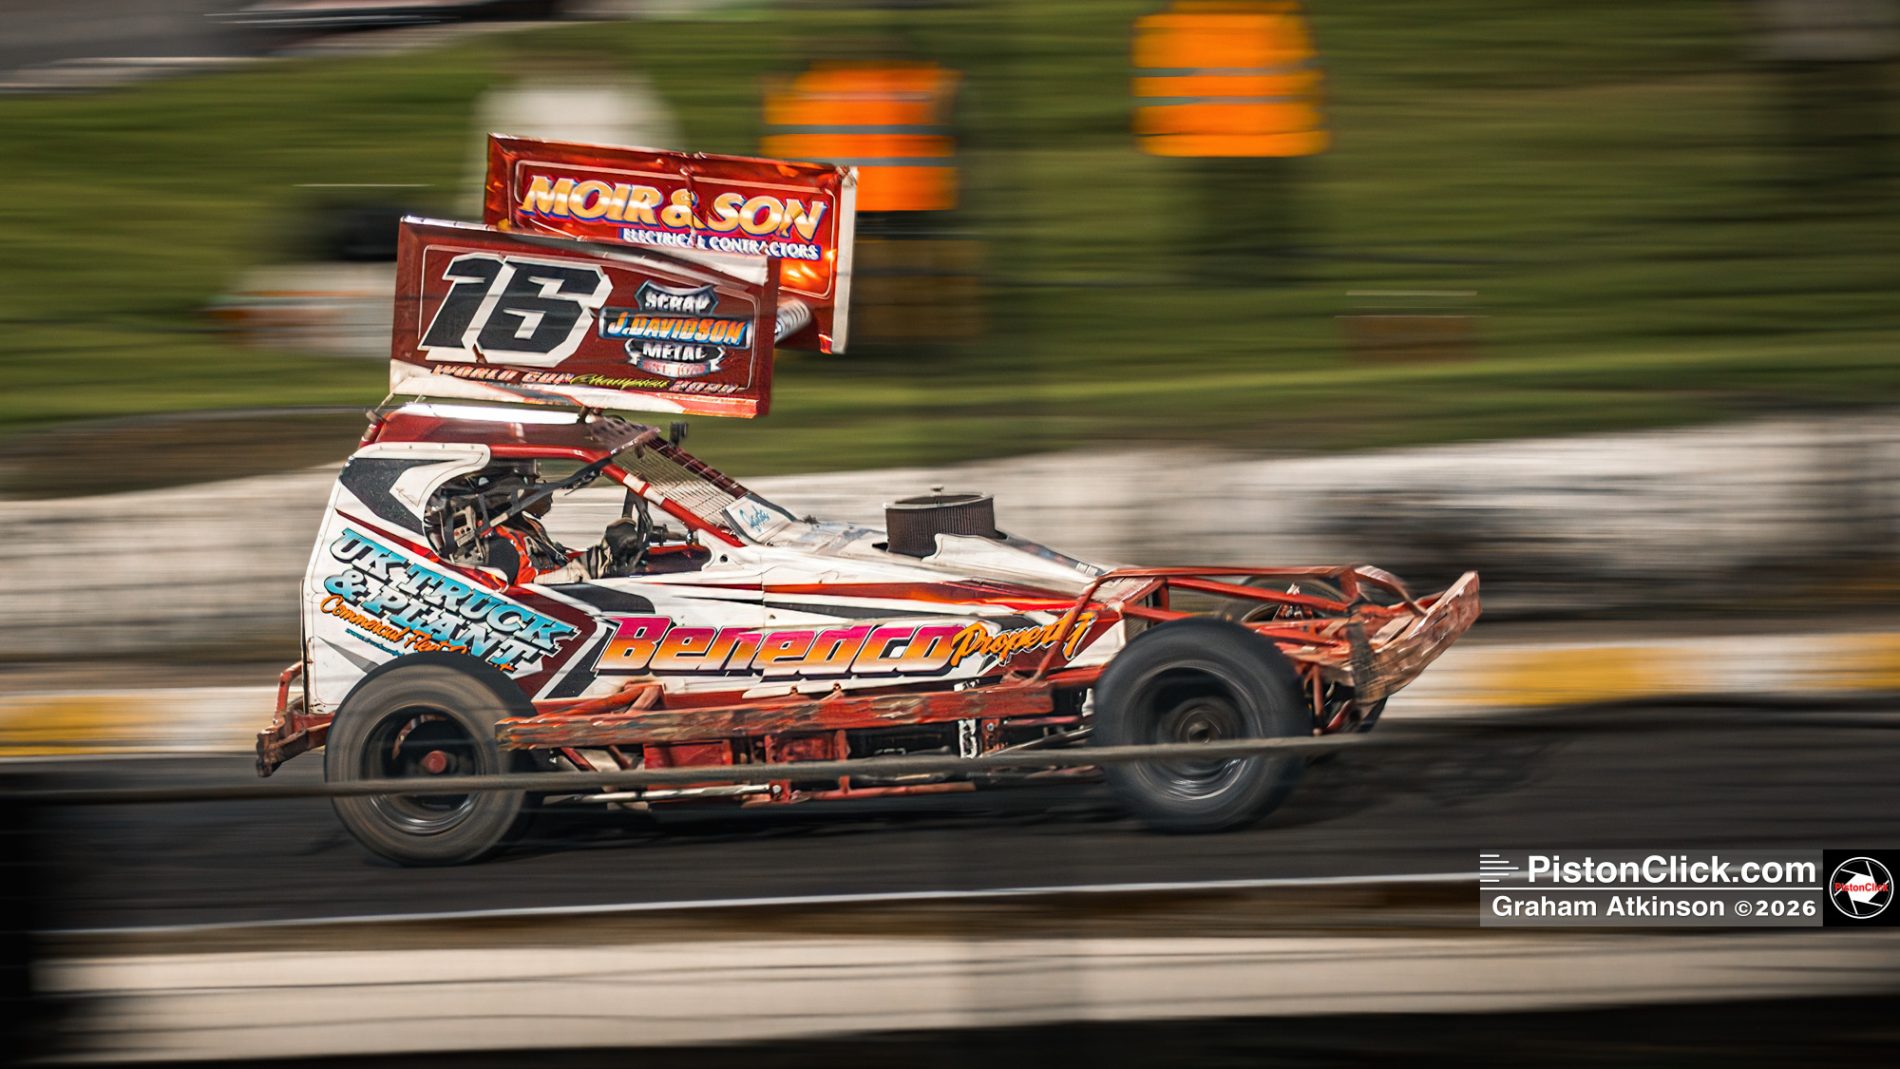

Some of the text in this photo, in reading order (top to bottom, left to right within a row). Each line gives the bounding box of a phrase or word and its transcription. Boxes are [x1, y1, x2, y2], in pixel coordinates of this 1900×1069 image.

[521, 175, 826, 241] MOIR & SON
[709, 237, 819, 260] CONTRACTORS
[418, 252, 613, 367] 16
[607, 311, 746, 344] J.DAVIDSON
[645, 292, 710, 314] SCRAP
[642, 343, 708, 361] METAL
[319, 594, 411, 643] Commercial
[330, 527, 578, 655] UK TRUCK
[360, 582, 530, 668] PLANT
[596, 614, 966, 678] Benedco
